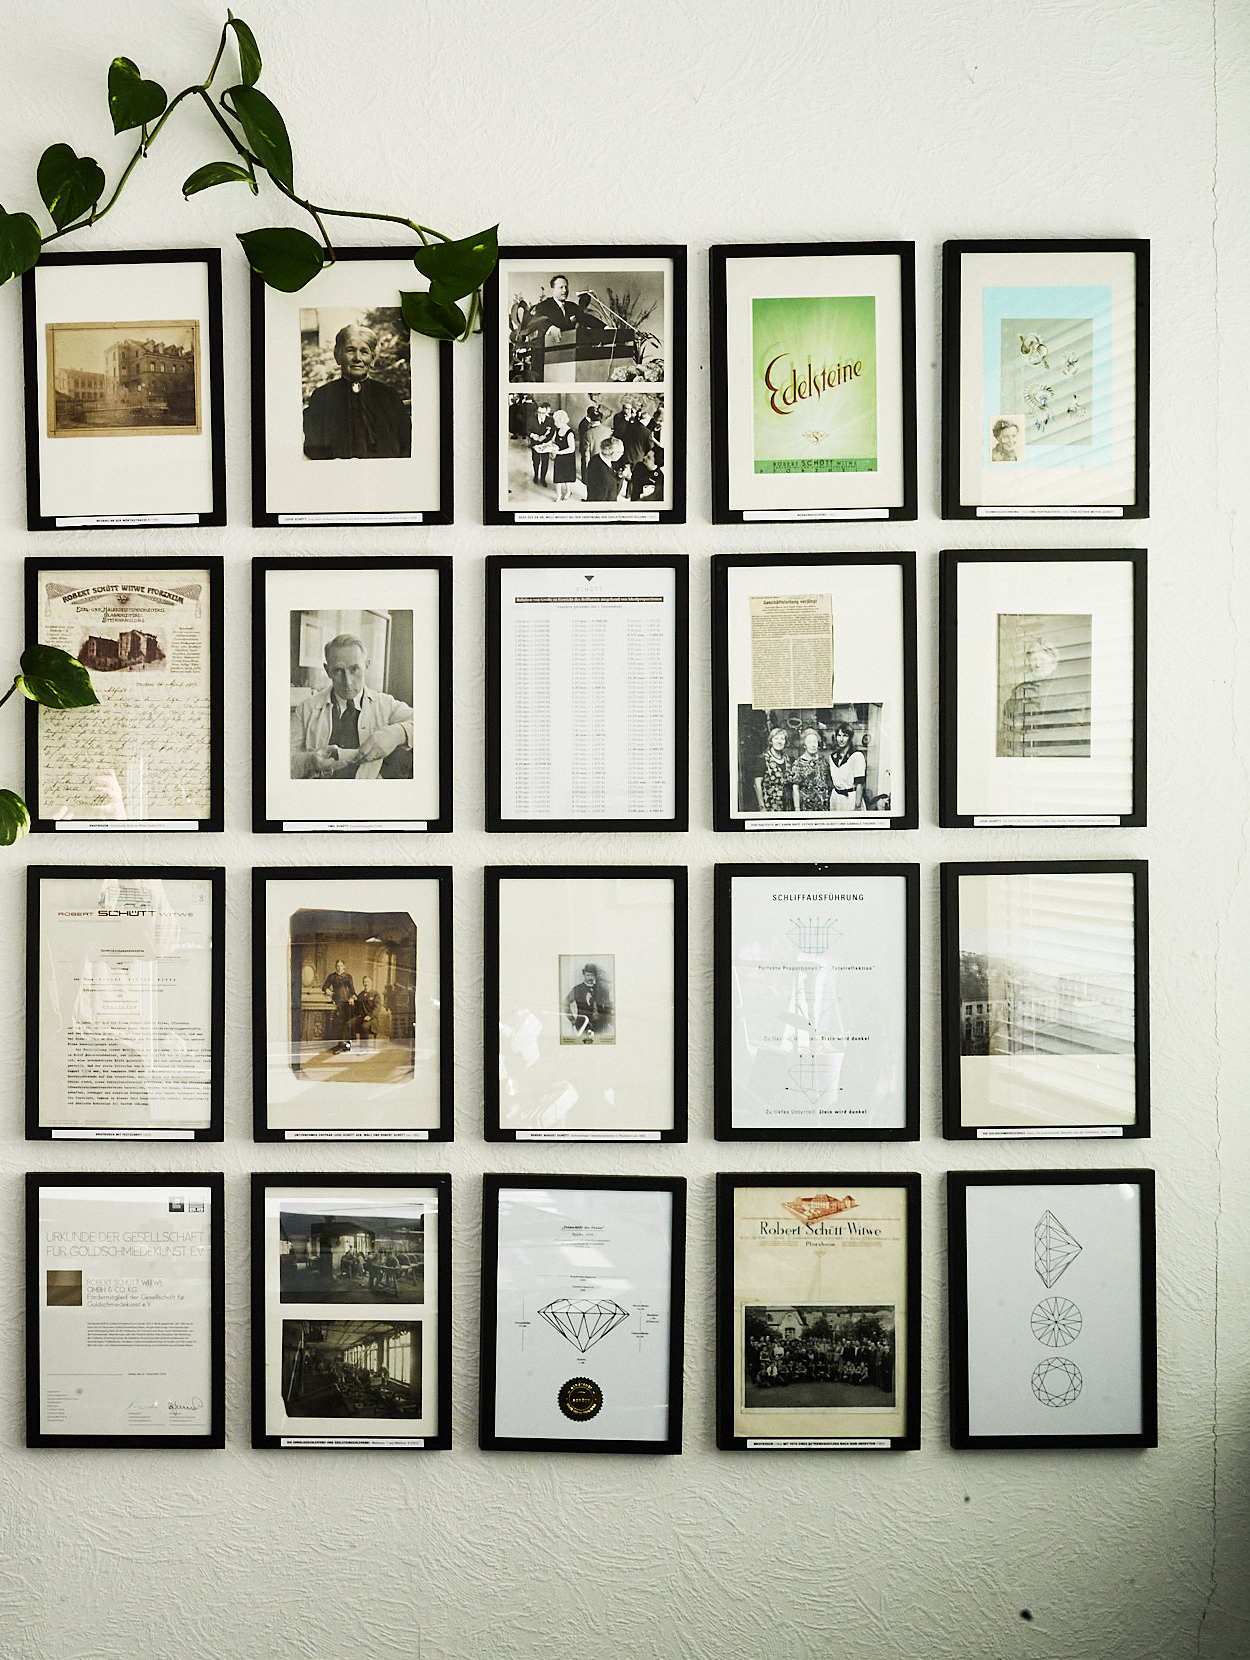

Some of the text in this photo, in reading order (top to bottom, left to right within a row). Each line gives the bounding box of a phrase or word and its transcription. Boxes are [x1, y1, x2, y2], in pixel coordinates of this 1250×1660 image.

[764, 352, 862, 415] Edelsteine
[62, 589, 90, 603] ROBERT
[92, 584, 119, 594] SCHÜTT
[121, 584, 145, 592] WITWE
[772, 893, 864, 901] SCHLIFFAUSFÜHRUNG
[46, 1231, 205, 1243] URKUNDE DER GESELLSCHAFT
[69, 1246, 188, 1257] GOLDSCHMIEDEKUNST
